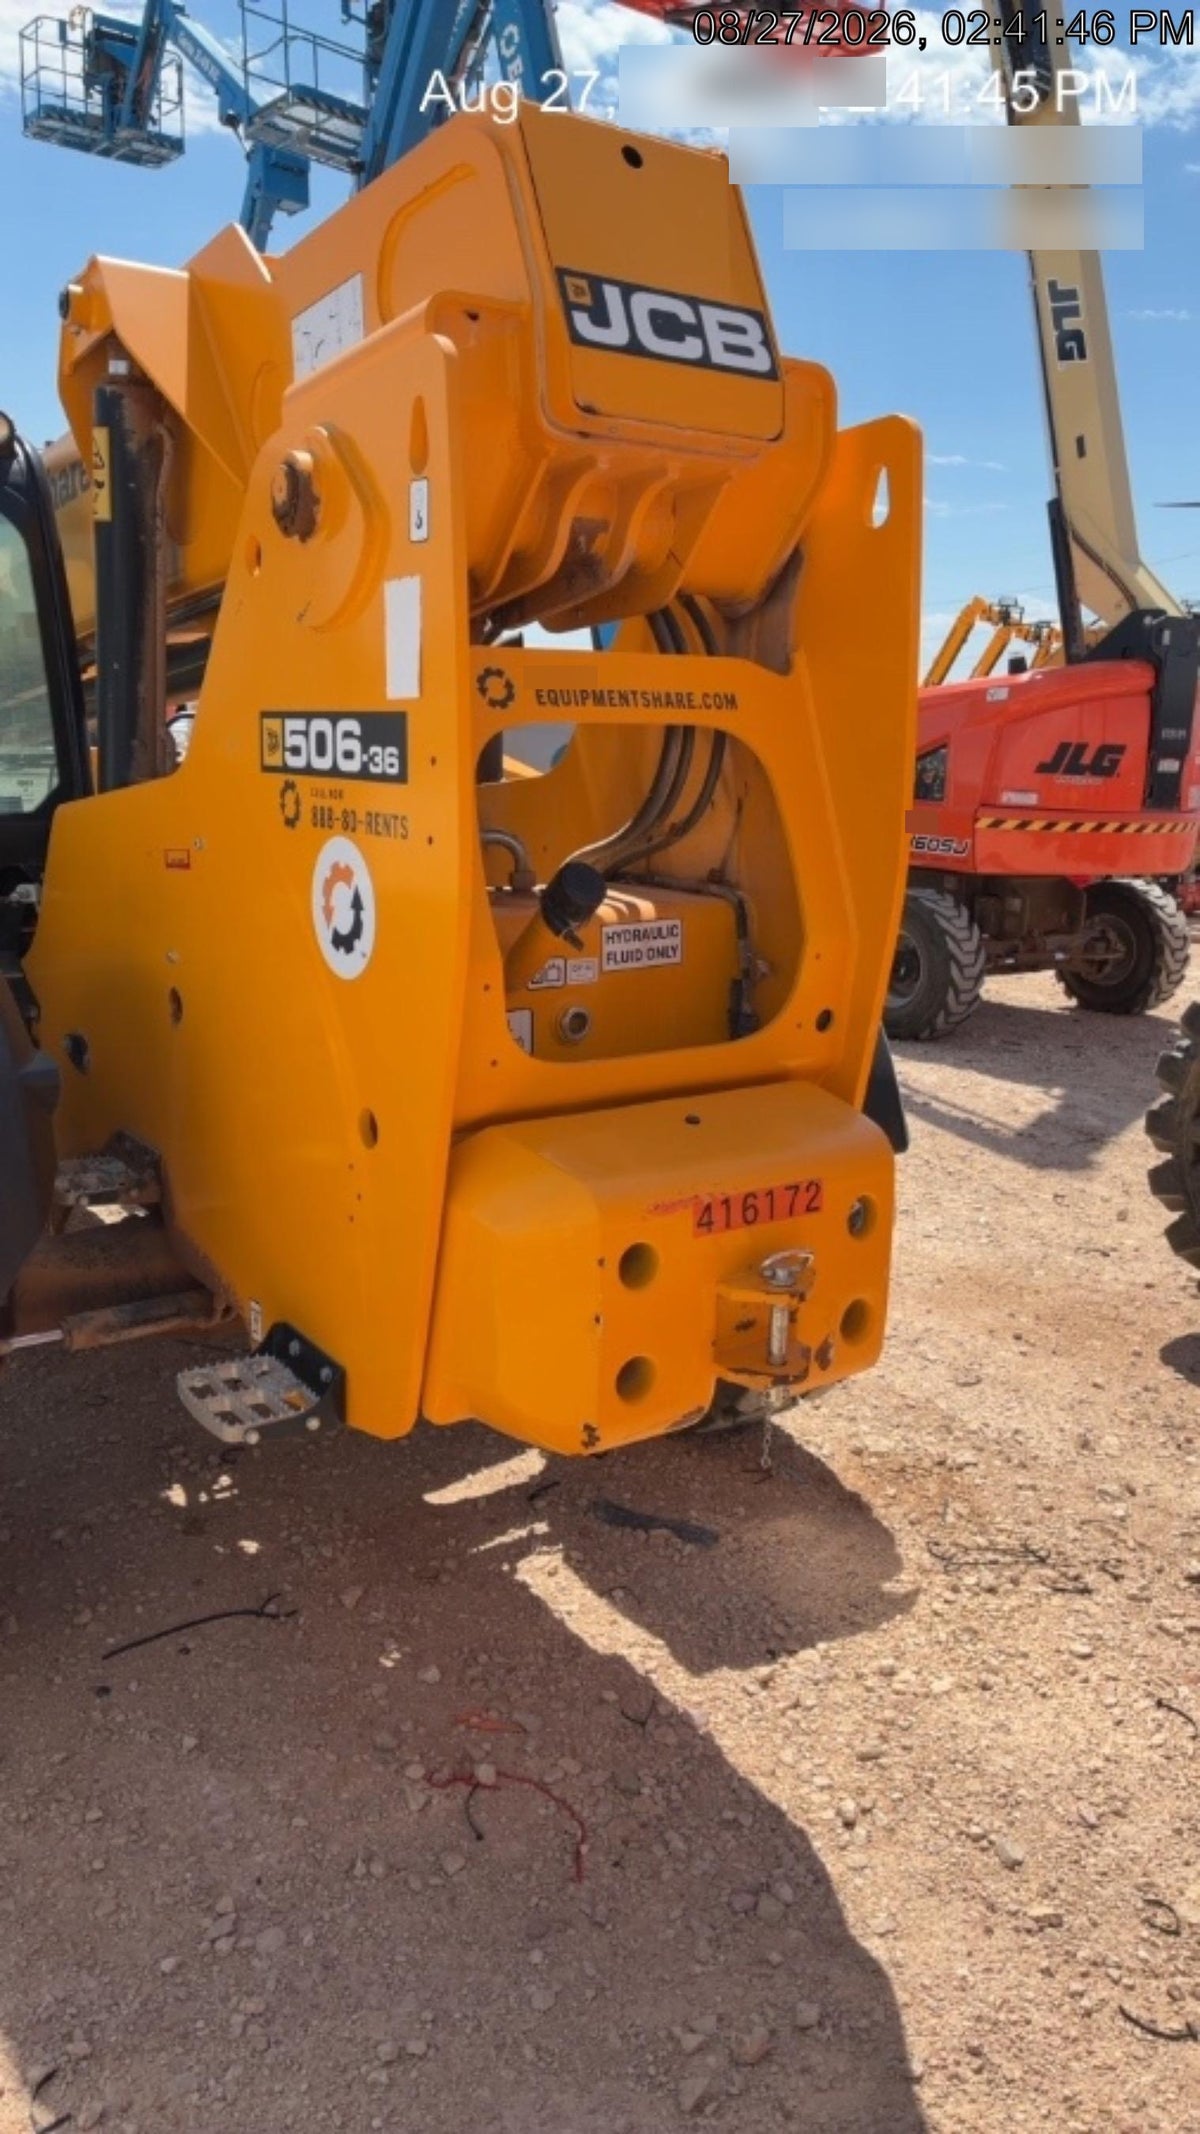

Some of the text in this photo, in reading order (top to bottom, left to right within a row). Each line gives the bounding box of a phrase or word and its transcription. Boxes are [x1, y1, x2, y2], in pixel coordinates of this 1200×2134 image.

[571, 283, 772, 373] JCB
[1047, 279, 1087, 361] JLG
[535, 689, 738, 710] EQUIPMENTSHARE.COM
[284, 717, 399, 775] 506-36
[1034, 742, 1126, 777] JLG
[605, 925, 679, 944] HYDRAULIC
[606, 944, 679, 966] FLUID ONLY
[697, 1180, 822, 1233] 416172
